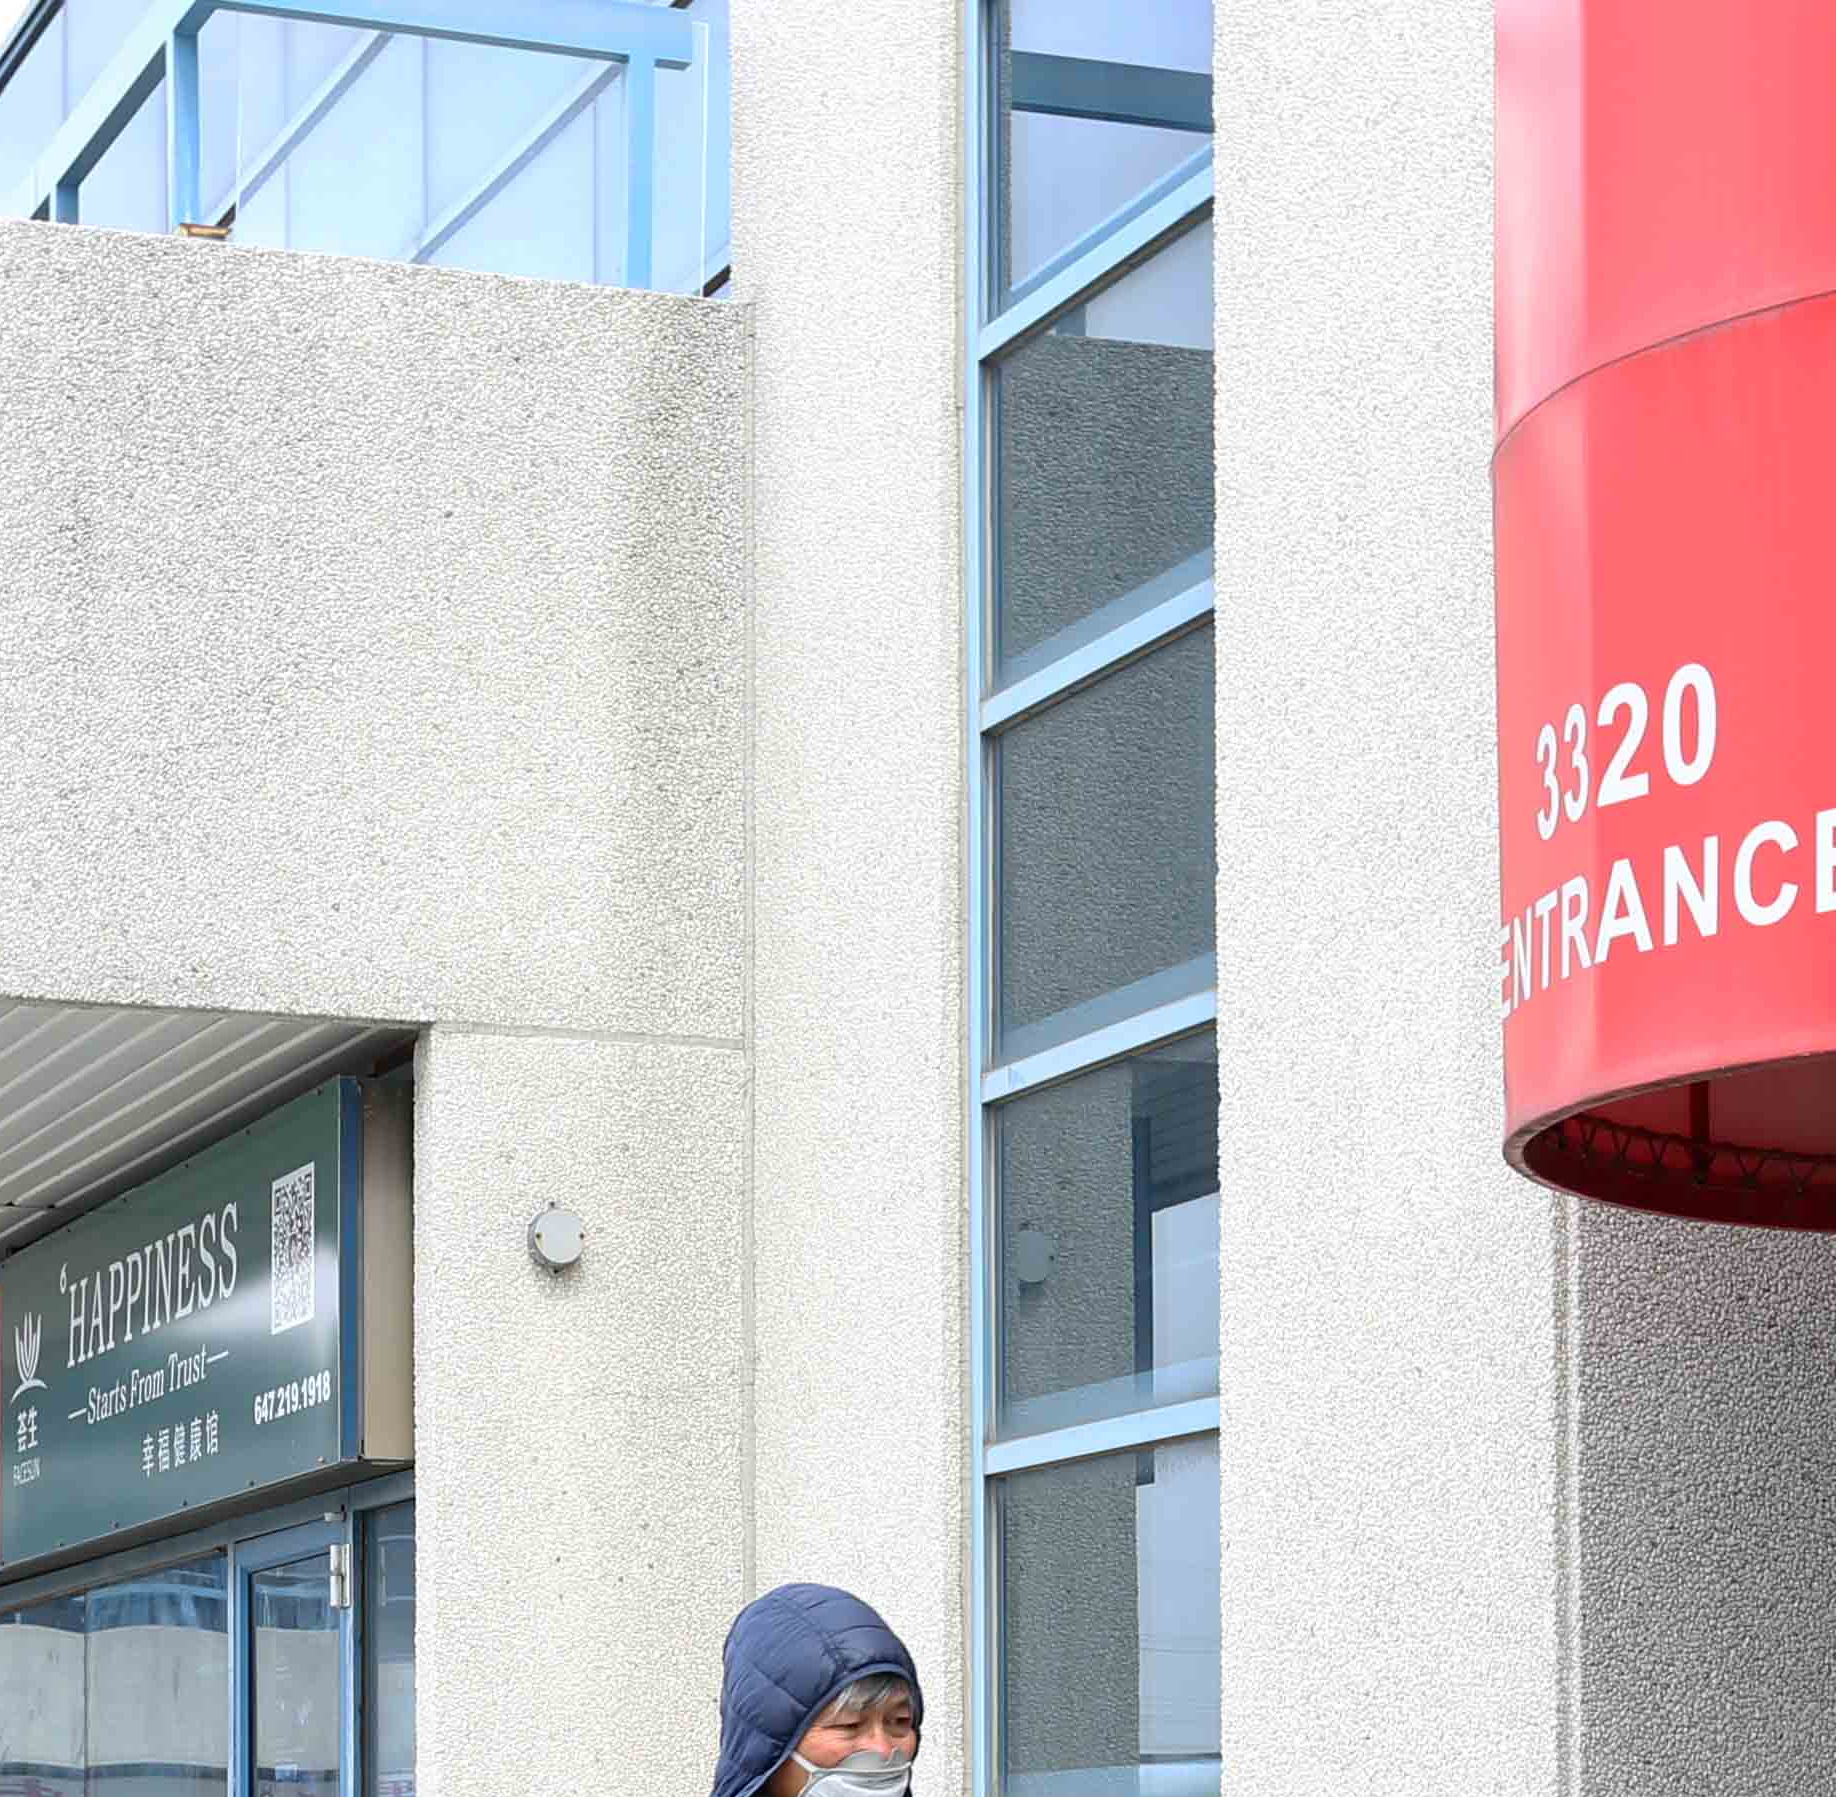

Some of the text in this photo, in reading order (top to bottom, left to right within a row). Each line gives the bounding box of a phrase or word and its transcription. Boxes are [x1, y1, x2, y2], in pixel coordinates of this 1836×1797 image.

[1536, 663, 1716, 840] 3320
[129, 1368, 164, 1408] From
[254, 1370, 331, 1424] 647.219.1918
[141, 1409, 220, 1478] 幸福健康馆
